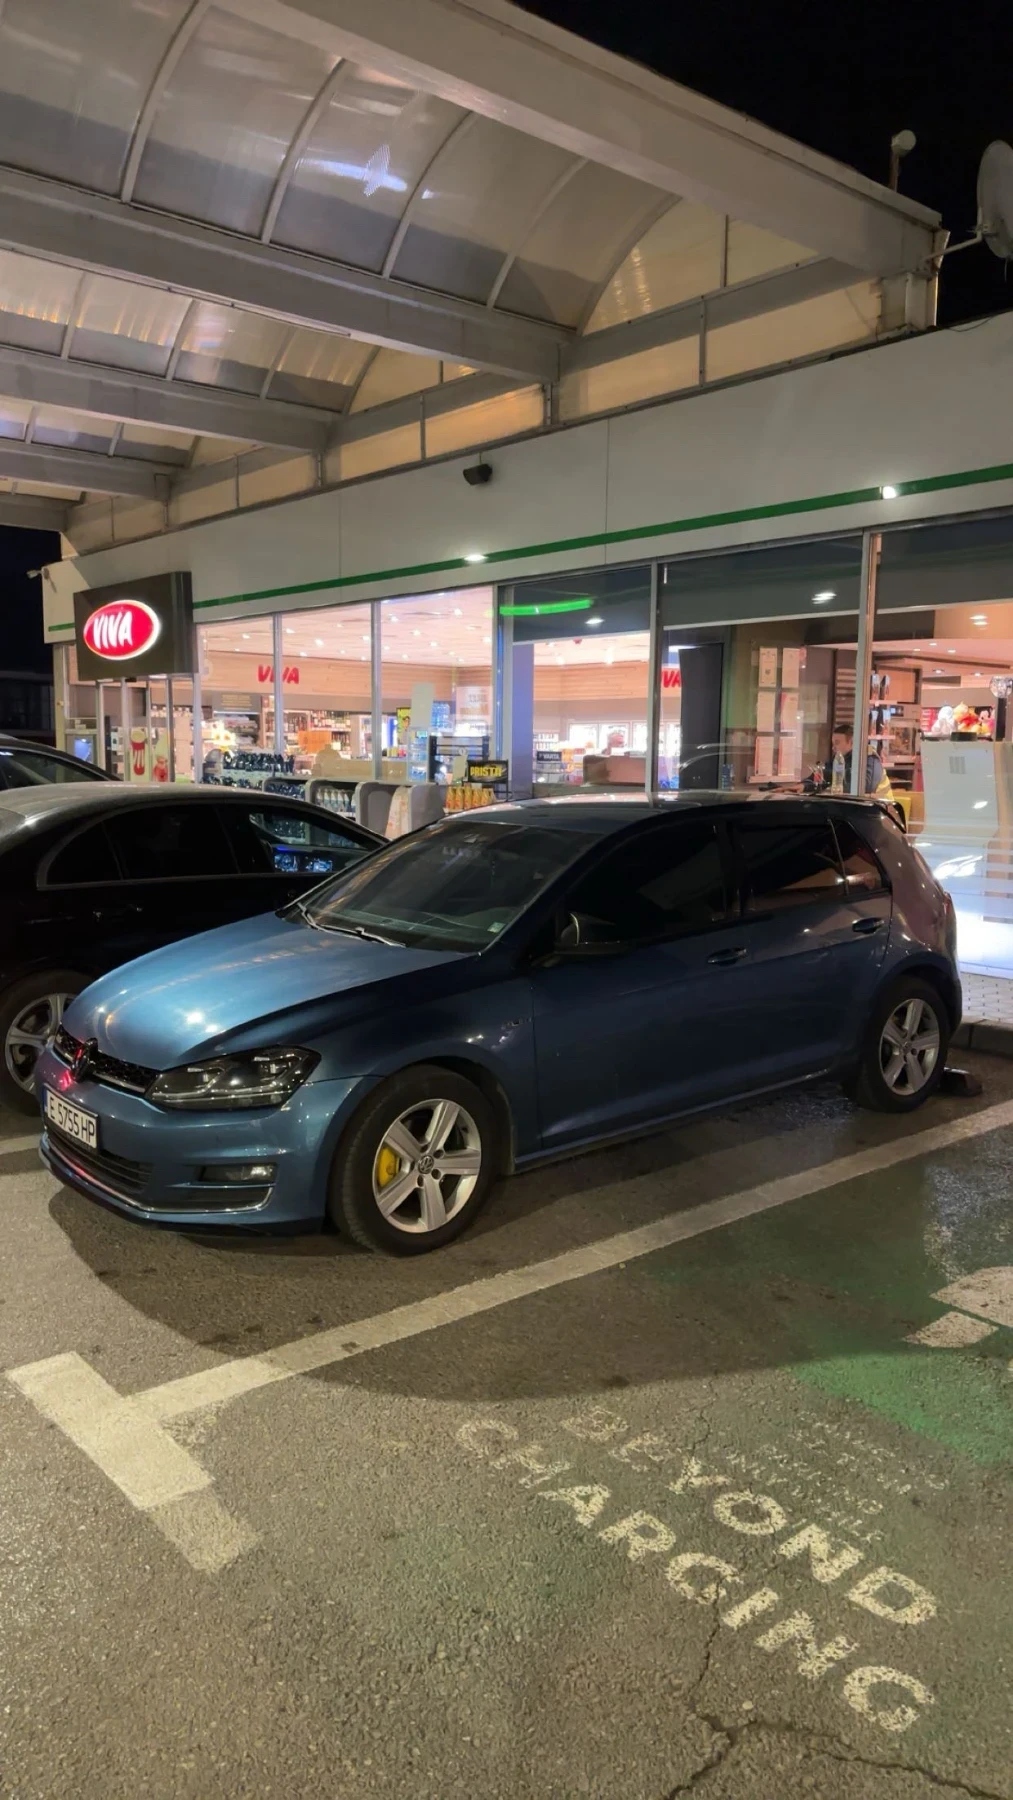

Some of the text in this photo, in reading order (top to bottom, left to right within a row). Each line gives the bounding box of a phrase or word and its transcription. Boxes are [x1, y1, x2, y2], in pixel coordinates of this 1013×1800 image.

[93, 610, 133, 650] VIVA
[58, 1102, 80, 1136] 5755
[80, 1116, 95, 1143] HP
[455, 1418, 936, 1733] CHARGING
